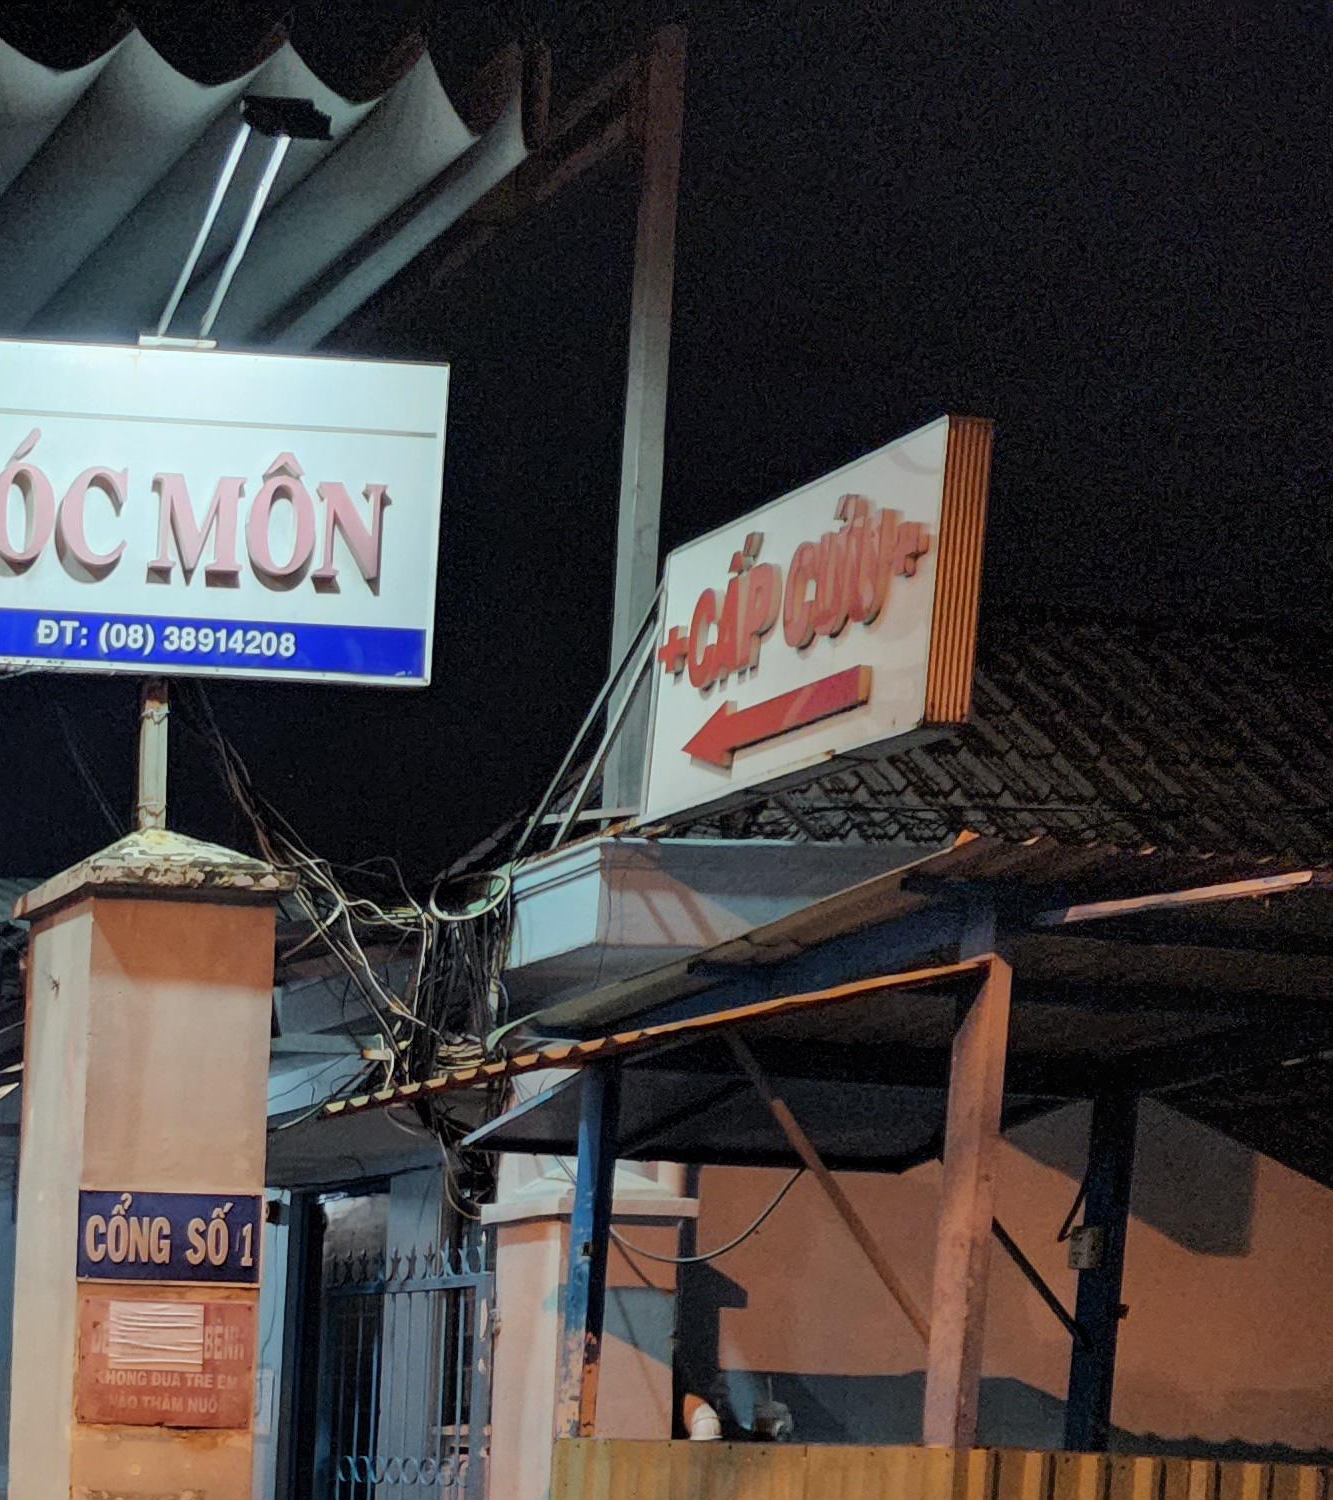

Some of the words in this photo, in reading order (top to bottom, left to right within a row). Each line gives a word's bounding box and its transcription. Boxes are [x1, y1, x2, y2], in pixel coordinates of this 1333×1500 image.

[146, 452, 392, 595] MÔN
[36, 618, 88, 648] ĐT:
[98, 620, 155, 655] (08)
[162, 628, 297, 658] 38914208
[686, 531, 783, 691] CẤP
[85, 1193, 171, 1266] CỔNG
[186, 1202, 232, 1267] SỐ
[240, 1223, 253, 1268] 1
